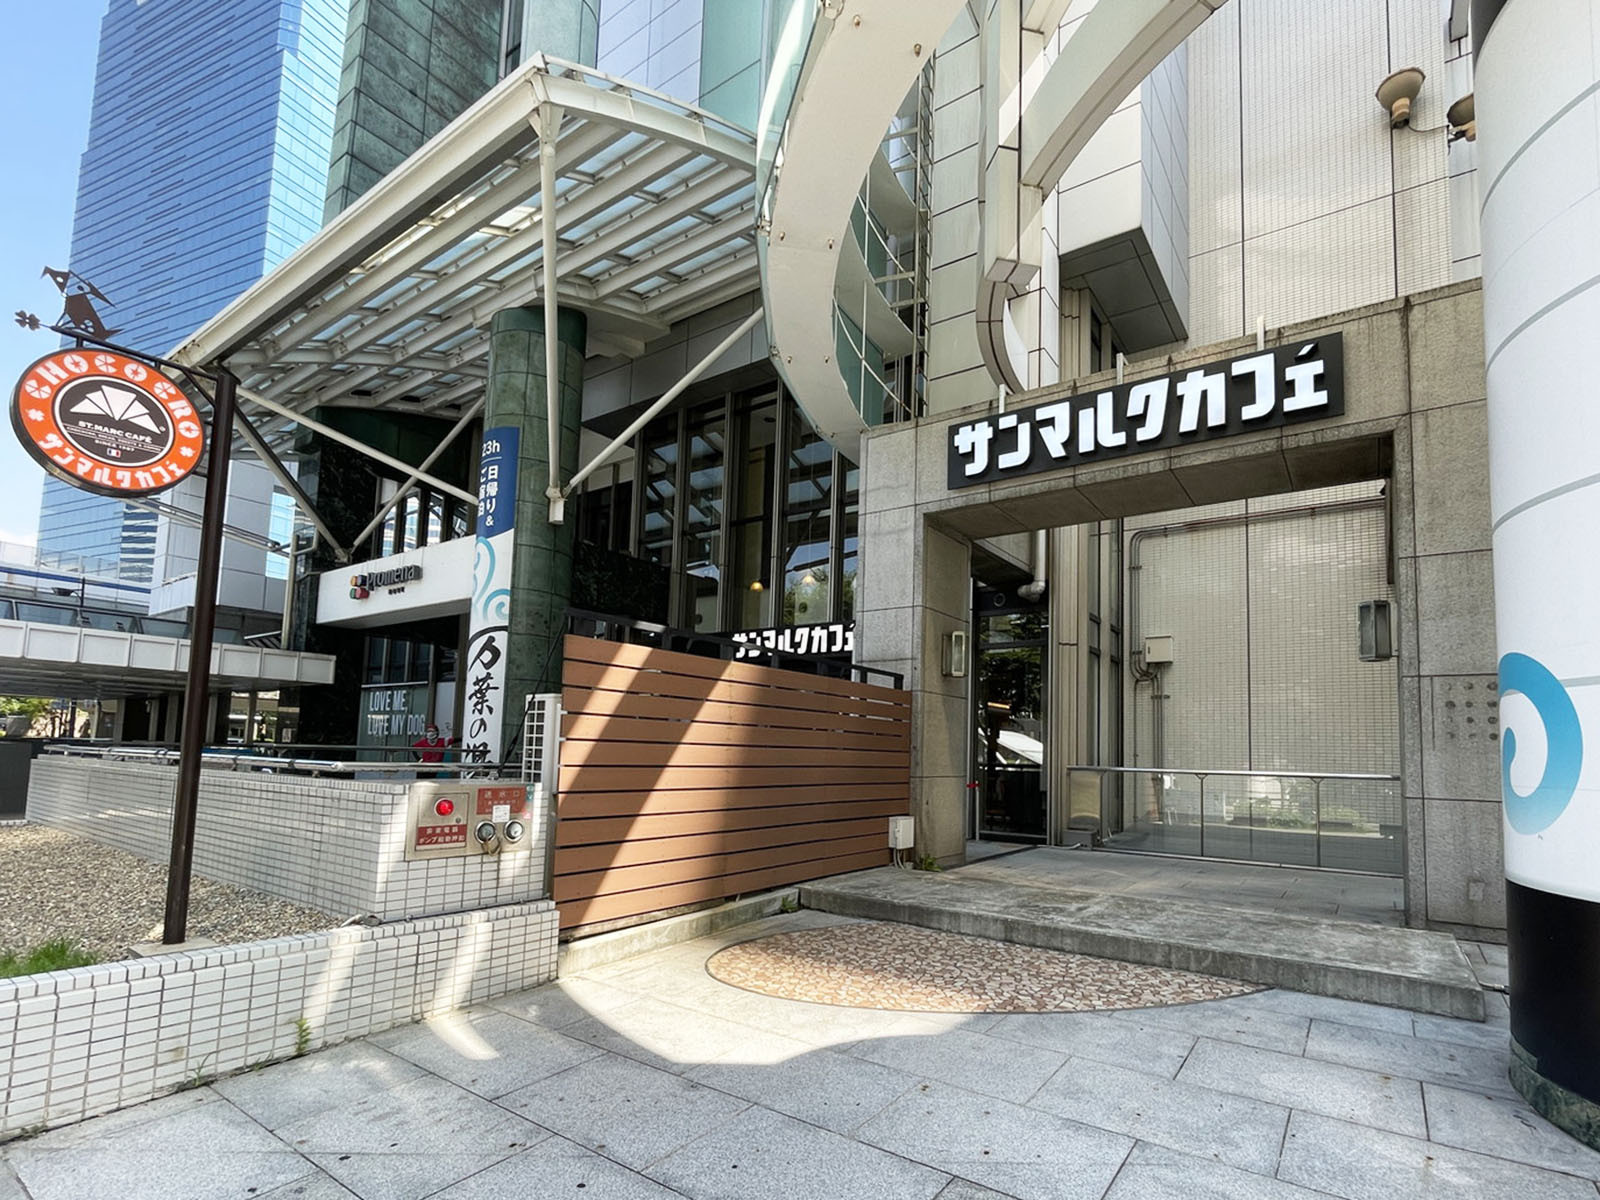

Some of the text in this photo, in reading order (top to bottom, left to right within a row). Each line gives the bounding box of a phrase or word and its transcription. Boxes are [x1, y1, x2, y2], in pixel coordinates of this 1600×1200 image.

[953, 342, 1329, 477] サンマルクカフェ
[38, 433, 187, 488] サンマルクカフェ
[369, 689, 392, 712] LOVE
[367, 714, 390, 736] LOVE
[391, 714, 406, 736] MY
